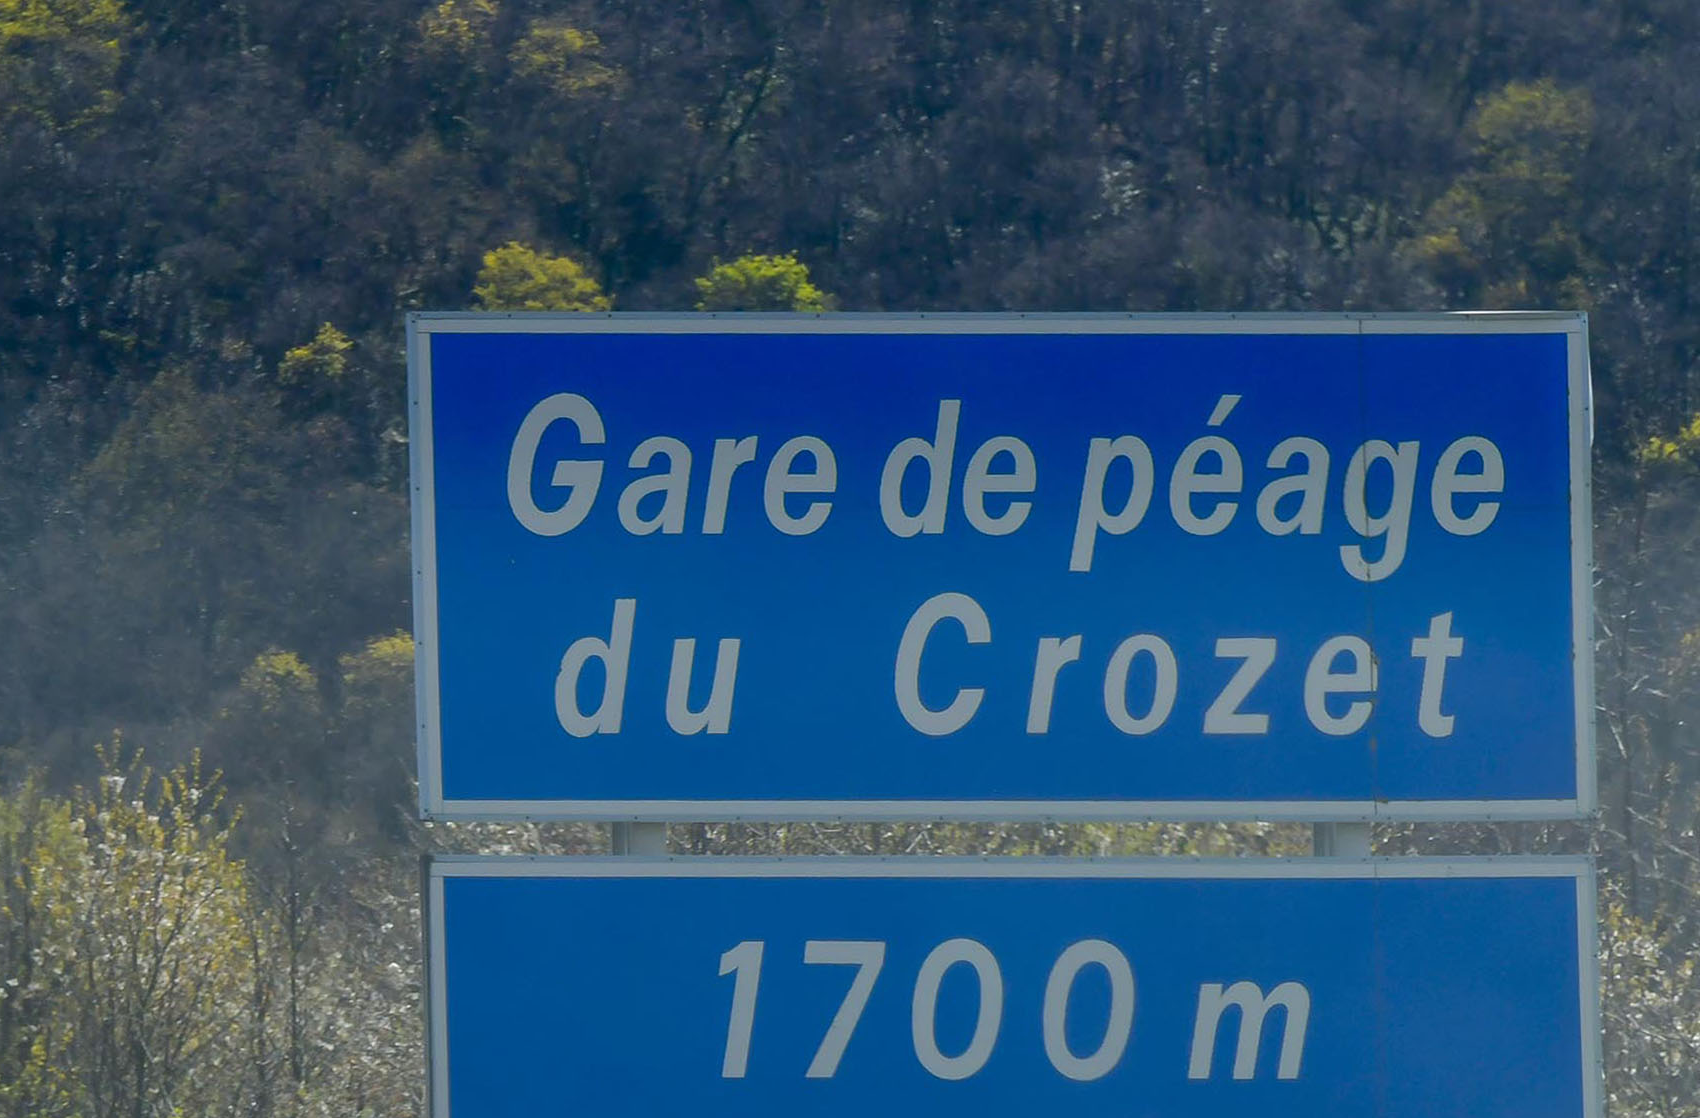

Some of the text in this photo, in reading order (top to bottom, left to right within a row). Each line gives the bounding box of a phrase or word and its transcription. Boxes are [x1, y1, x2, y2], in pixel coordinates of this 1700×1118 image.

[507, 392, 1505, 582] Gare de péage
[554, 592, 1464, 738] du Crozet
[718, 938, 1311, 1081] 1700 m
